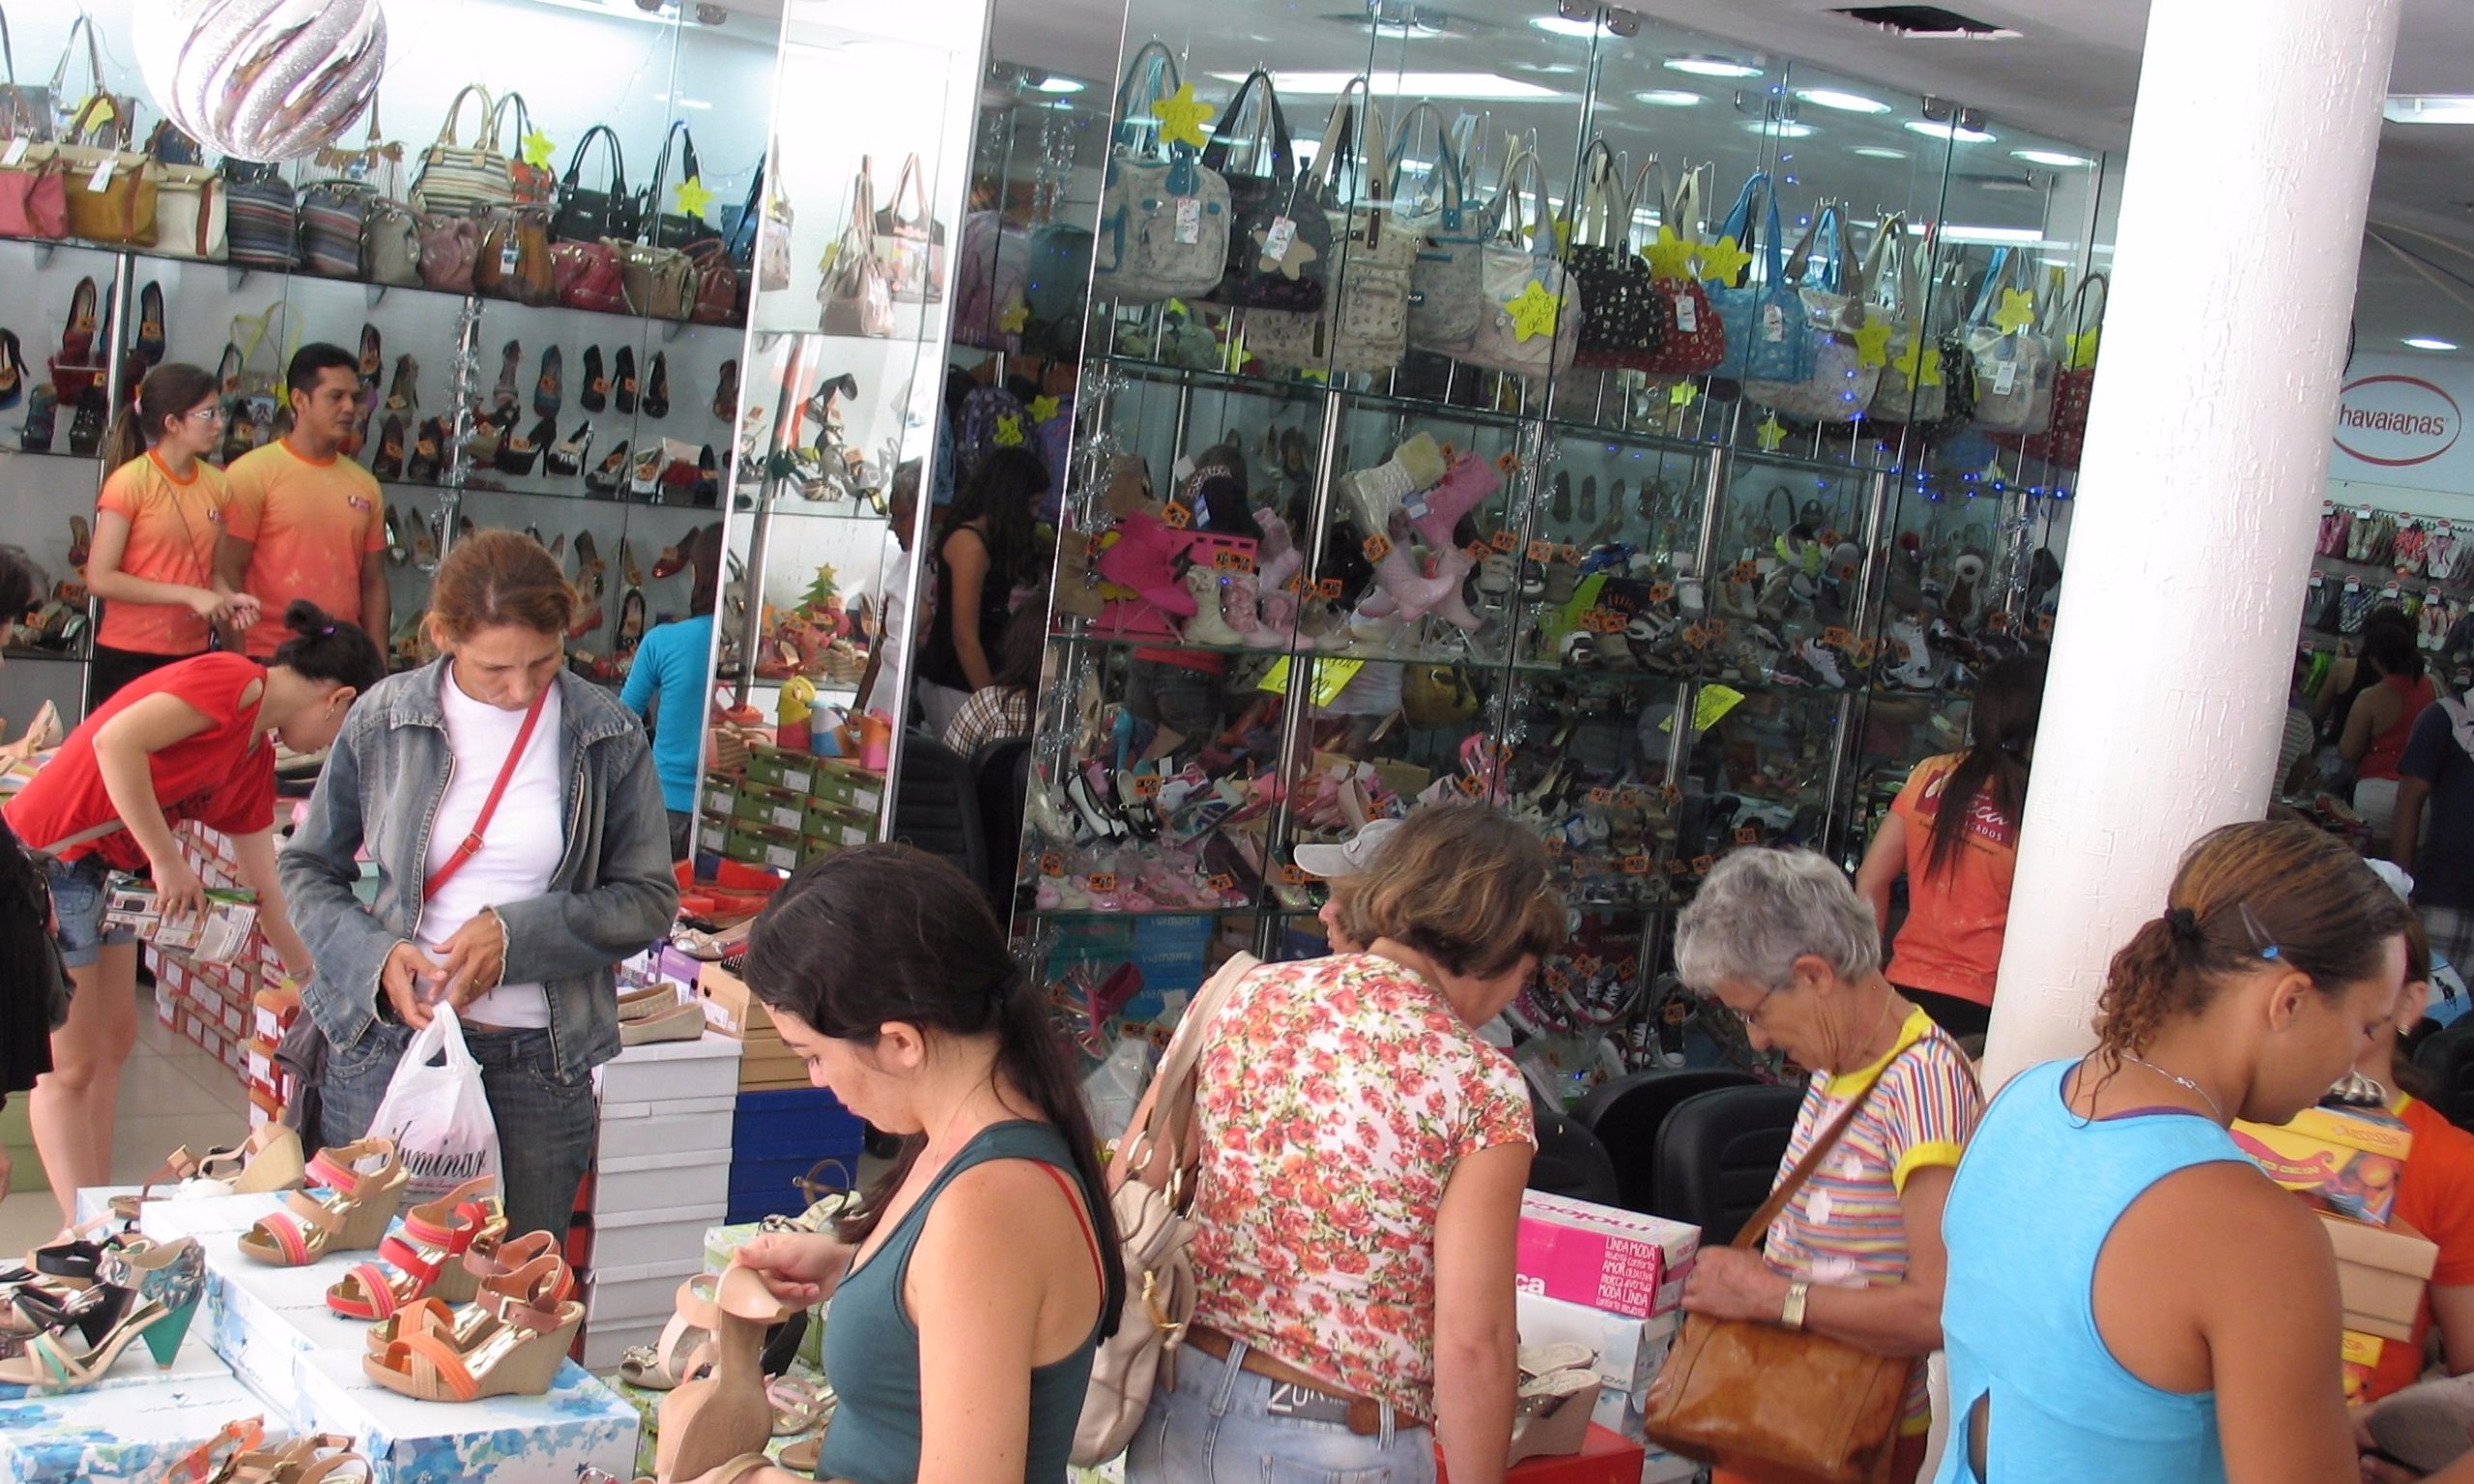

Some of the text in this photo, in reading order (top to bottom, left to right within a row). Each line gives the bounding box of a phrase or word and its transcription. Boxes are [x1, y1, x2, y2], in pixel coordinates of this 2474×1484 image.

[2339, 403, 2445, 436] havaianas
[1605, 1236, 1629, 1253] LINDA
[1628, 1241, 1655, 1261] MODA
[1601, 1258, 1626, 1276] AMOR
[1597, 1282, 1648, 1307] MODA LINDA
